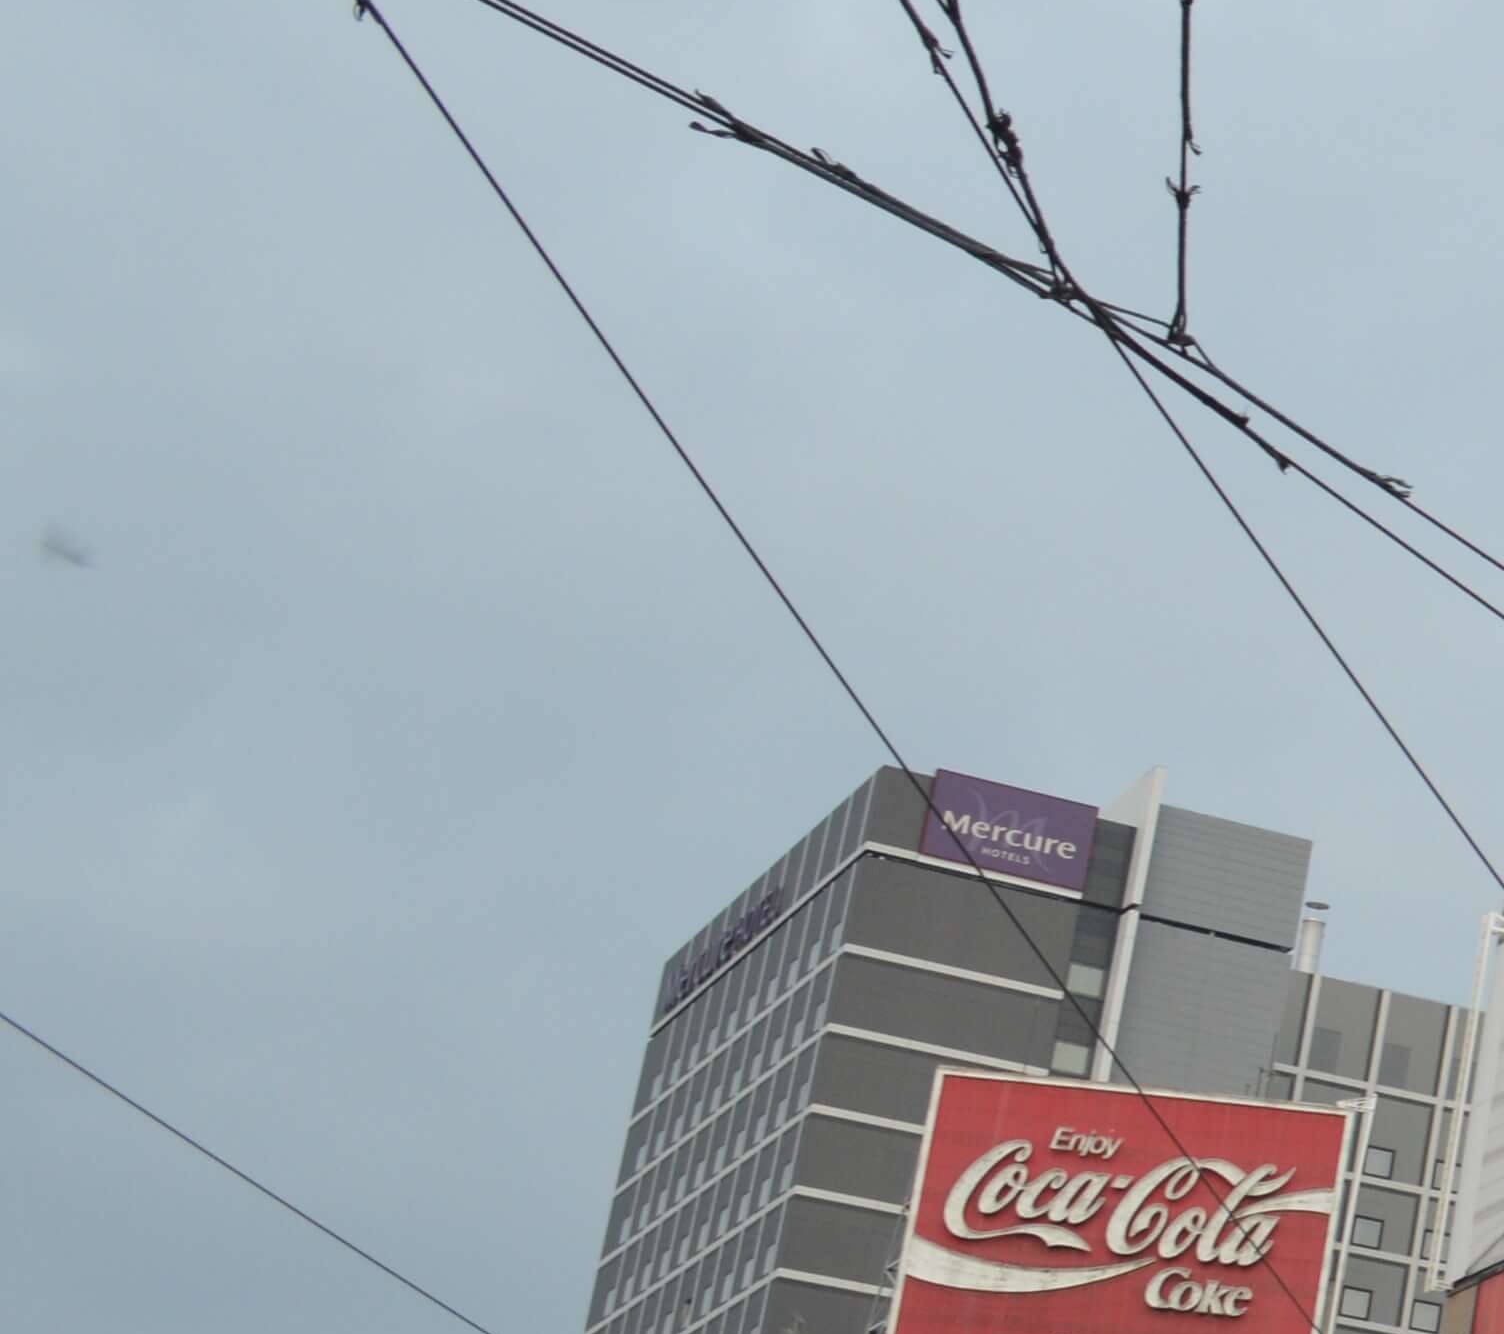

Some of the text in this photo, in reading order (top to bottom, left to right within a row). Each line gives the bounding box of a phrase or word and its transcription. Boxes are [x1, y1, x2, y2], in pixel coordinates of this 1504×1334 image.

[943, 809, 1077, 859] Mercure
[1050, 1126, 1126, 1158] Enjoy
[944, 1140, 1296, 1267] Coca-Cola
[1145, 1267, 1252, 1317] Coke
